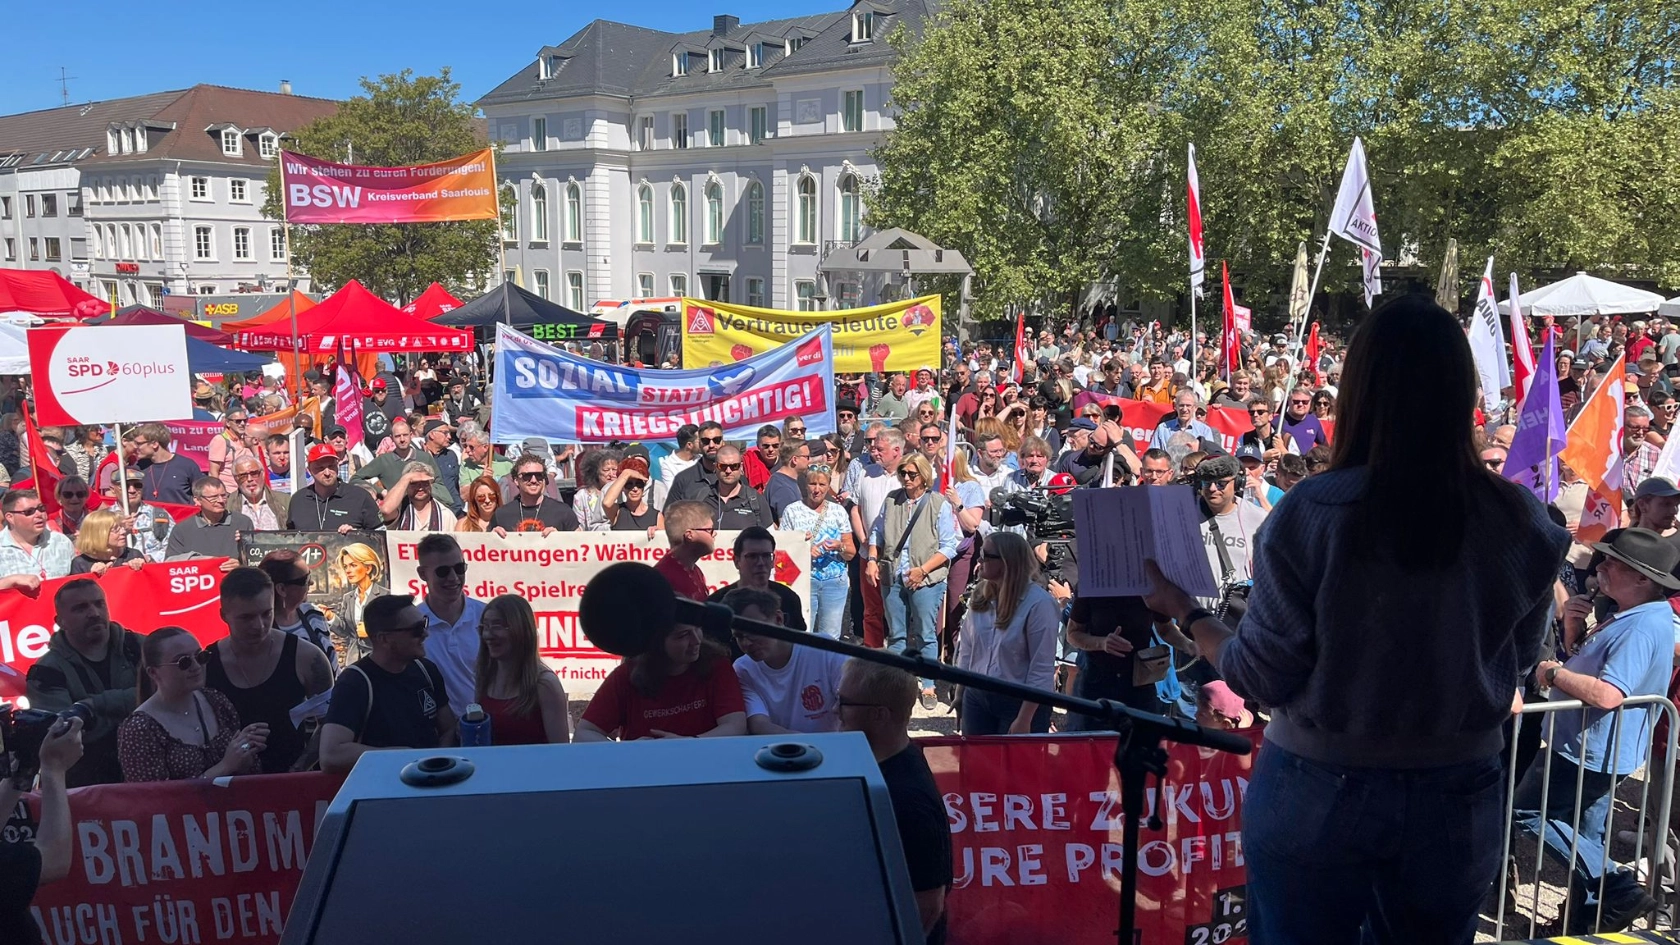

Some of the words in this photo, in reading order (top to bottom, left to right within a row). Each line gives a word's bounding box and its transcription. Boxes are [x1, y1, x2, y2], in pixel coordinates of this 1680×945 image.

[287, 162, 307, 175] Wir
[311, 167, 352, 178] stehen
[356, 168, 370, 177] zu
[373, 168, 407, 178] euren
[410, 160, 485, 177] Forderungen!
[289, 183, 362, 208] BSW
[367, 191, 438, 201] Kreisverband
[440, 186, 490, 198] Saarlouis
[1350, 218, 1379, 239] AKTIO
[213, 303, 239, 315] ASB
[533, 323, 578, 339] BEST
[377, 338, 395, 347] EVG
[68, 363, 104, 377] SPD
[122, 361, 175, 381] 60plus
[514, 356, 631, 394] SOZIAL
[641, 386, 706, 404] STATT
[189, 427, 203, 435] zu
[1201, 531, 1246, 548] dias
[595, 543, 671, 561] Währe
[169, 566, 199, 576] SAAR
[170, 575, 215, 594] SPD
[475, 580, 508, 598] die
[513, 580, 588, 602] Spielre
[570, 667, 607, 680] nicht
[643, 699, 707, 719] GEWERKSCHAFTER
[944, 791, 1071, 834] SERE
[952, 843, 1048, 889] URE
[132, 894, 202, 945] FÜR
[211, 890, 284, 940] DEN
[1191, 918, 1248, 945] 202
